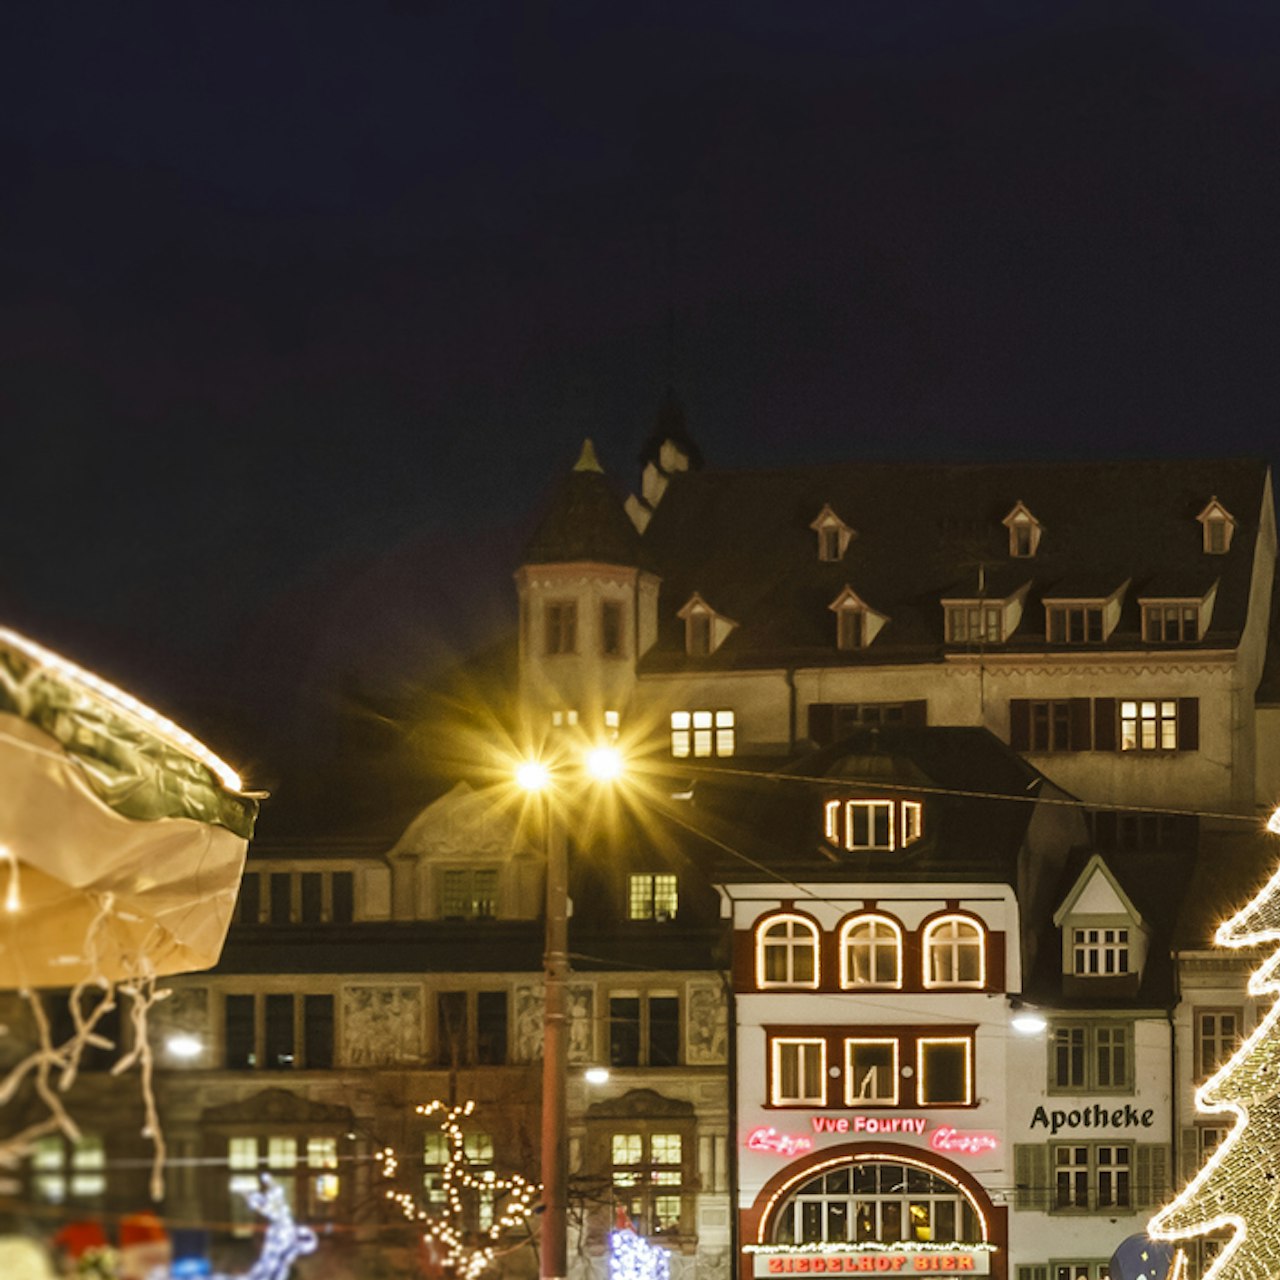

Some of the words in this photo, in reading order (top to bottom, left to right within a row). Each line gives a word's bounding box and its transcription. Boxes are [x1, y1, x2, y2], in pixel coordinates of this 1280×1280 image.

[811, 1116, 849, 1134] Vve
[853, 1116, 927, 1135] Fourny
[1029, 1104, 1155, 1135] Apotheke
[767, 1256, 906, 1273] ZIEGELHOF
[913, 1255, 975, 1272] BIER
